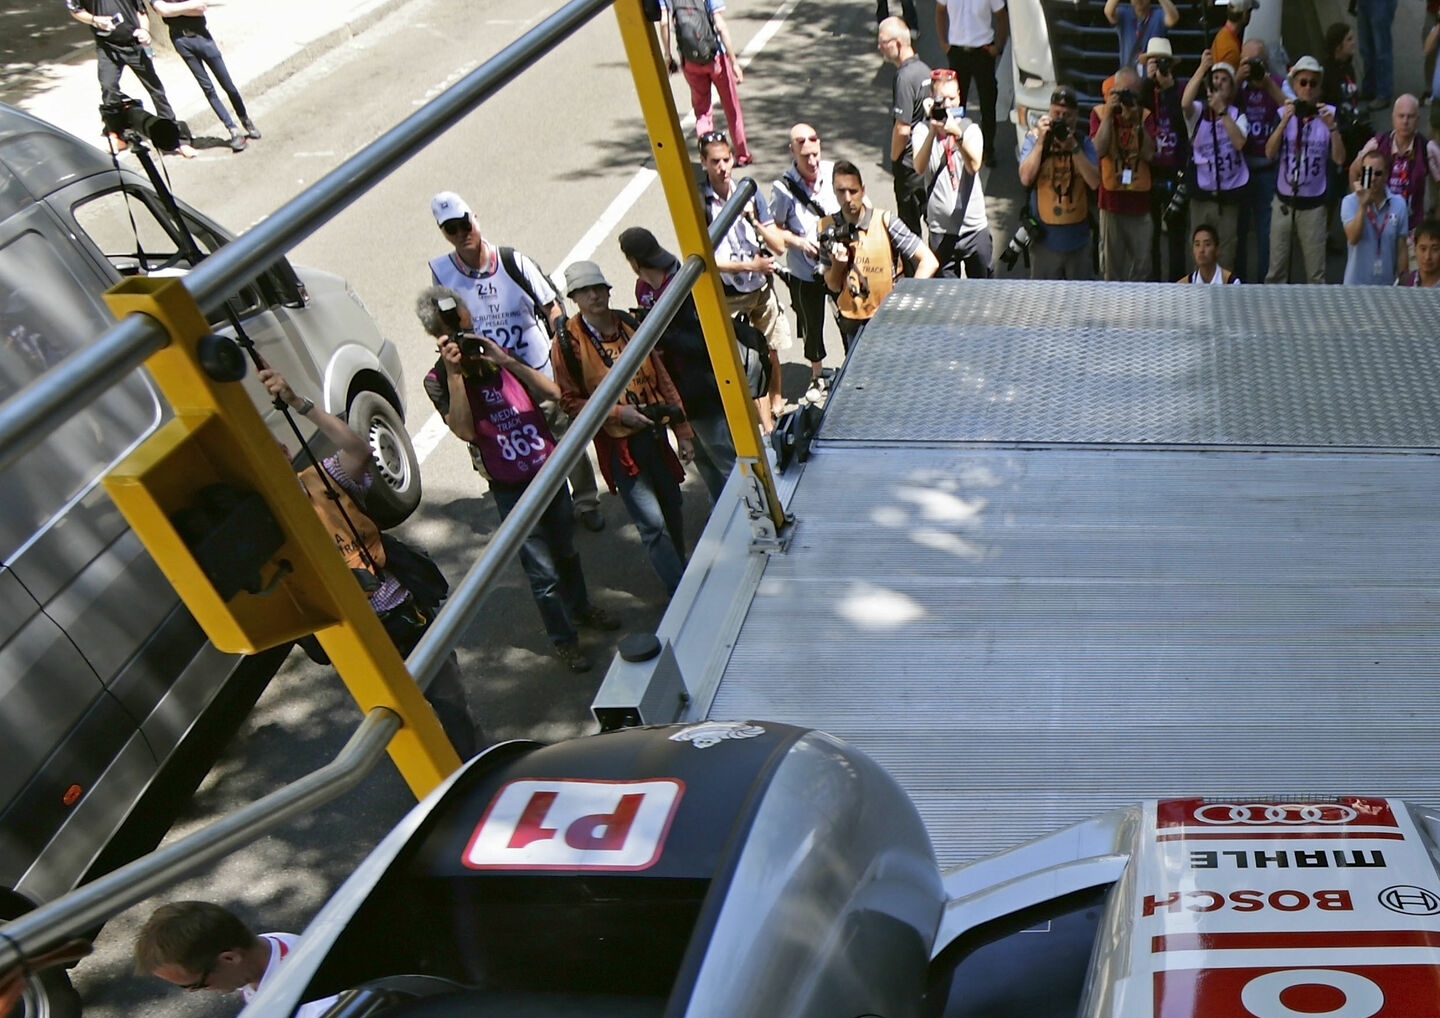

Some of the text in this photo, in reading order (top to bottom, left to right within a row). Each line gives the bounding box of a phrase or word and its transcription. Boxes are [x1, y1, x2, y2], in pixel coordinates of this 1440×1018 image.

[488, 304, 500, 313] TV
[490, 405, 520, 423] MEDIA
[497, 417, 522, 432] TRACK
[496, 424, 546, 461] 863
[506, 791, 646, 851] P1
[1190, 850, 1388, 869] MAHLE
[1142, 888, 1355, 918] BOSCH
